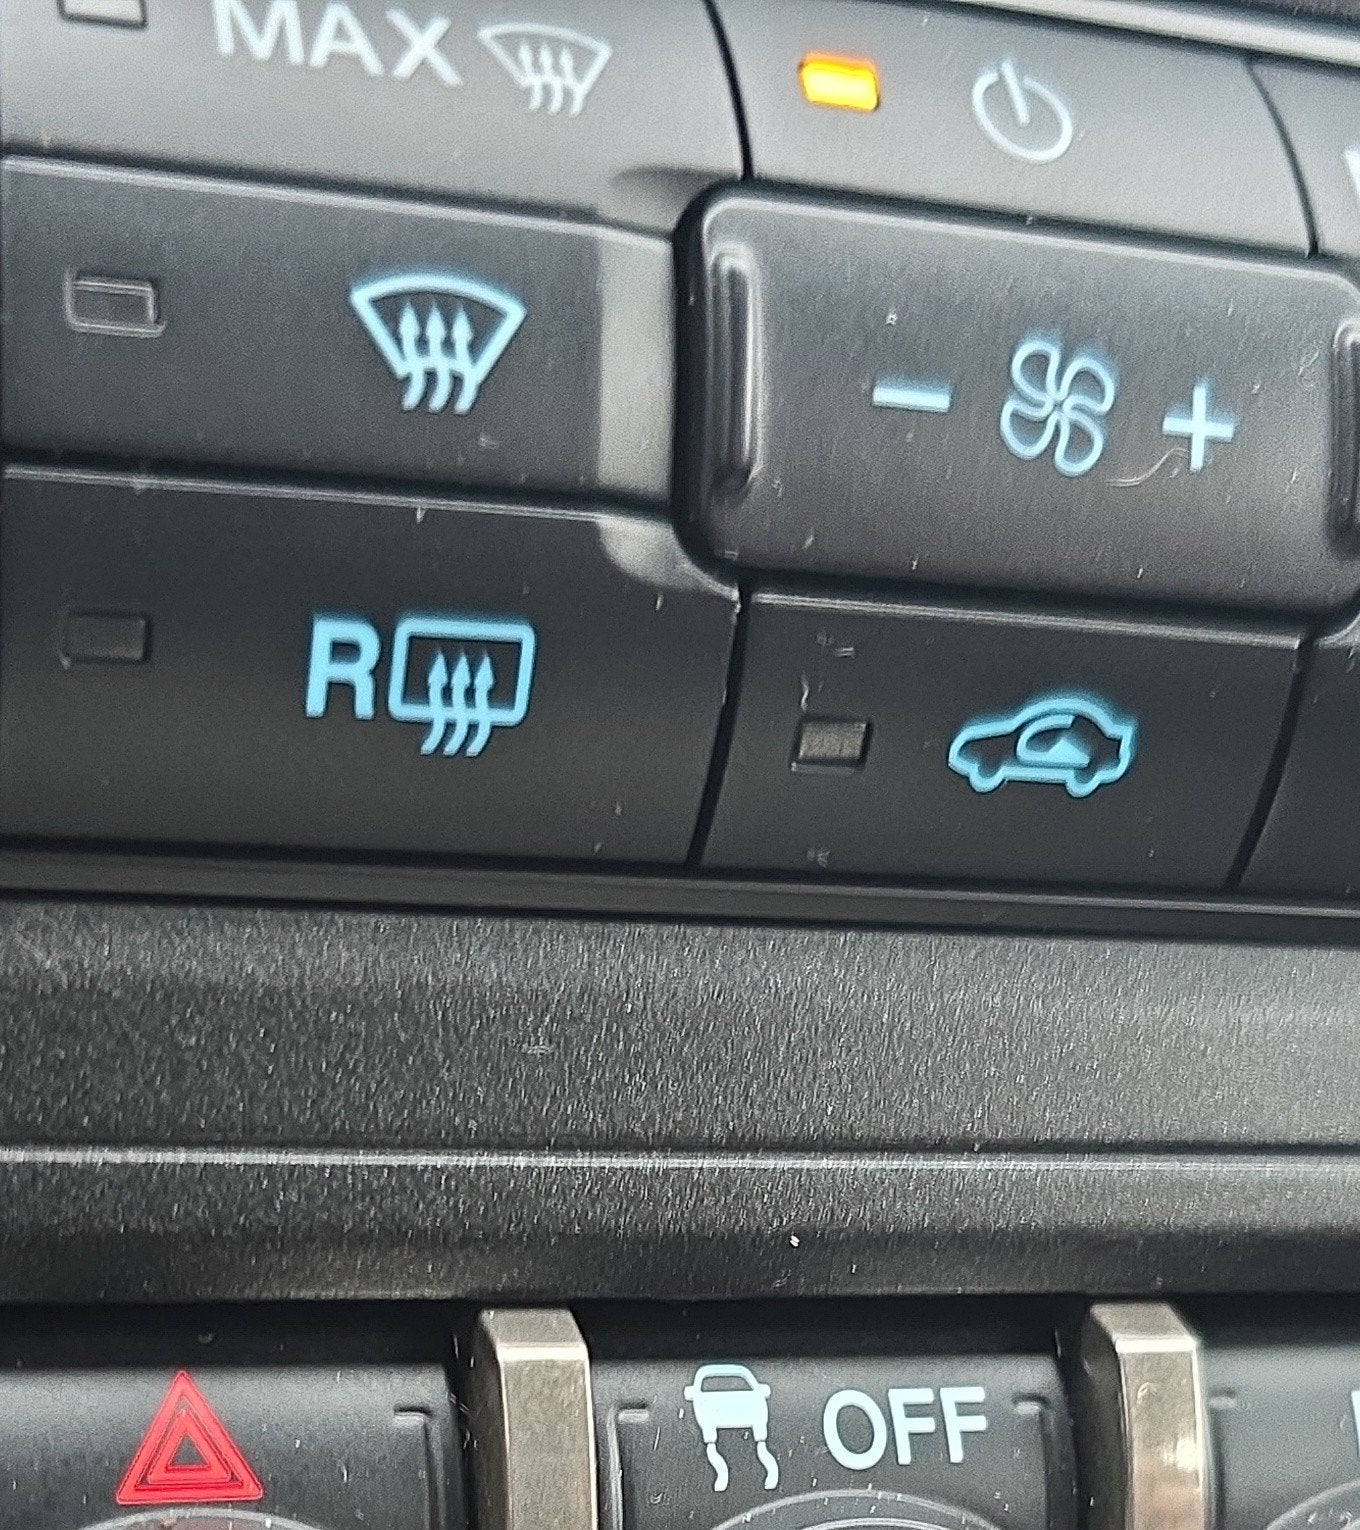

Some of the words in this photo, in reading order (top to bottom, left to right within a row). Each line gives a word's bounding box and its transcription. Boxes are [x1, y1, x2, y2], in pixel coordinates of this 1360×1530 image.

[212, 0, 463, 87] MAX
[305, 613, 380, 718] R
[822, 1386, 989, 1469] OFF
